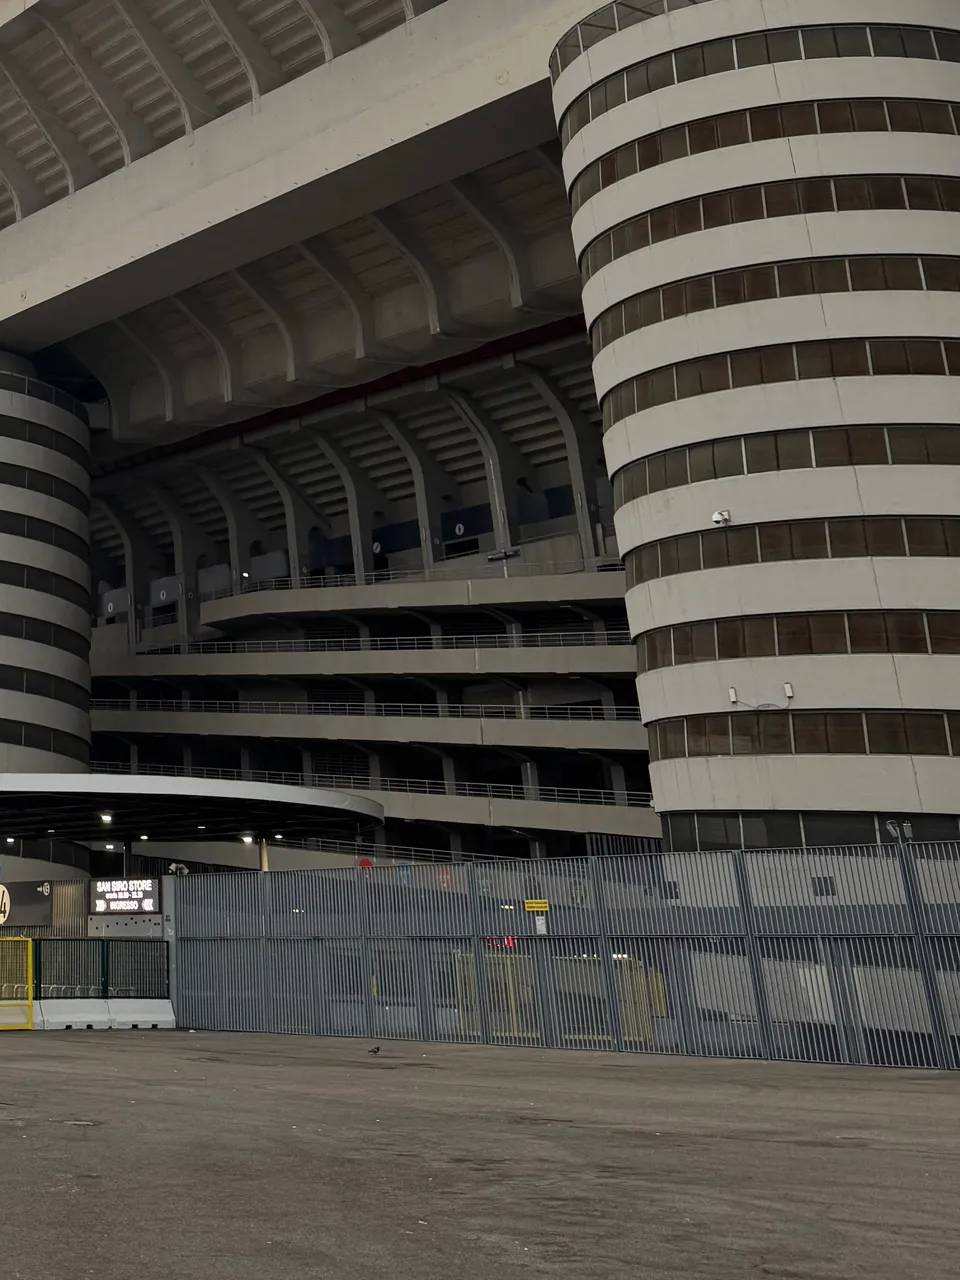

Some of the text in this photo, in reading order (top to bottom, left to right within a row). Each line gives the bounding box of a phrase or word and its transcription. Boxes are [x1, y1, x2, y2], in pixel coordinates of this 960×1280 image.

[96, 880, 152, 892] SAN SIRO STORE
[110, 901, 139, 910] INGRESSO
